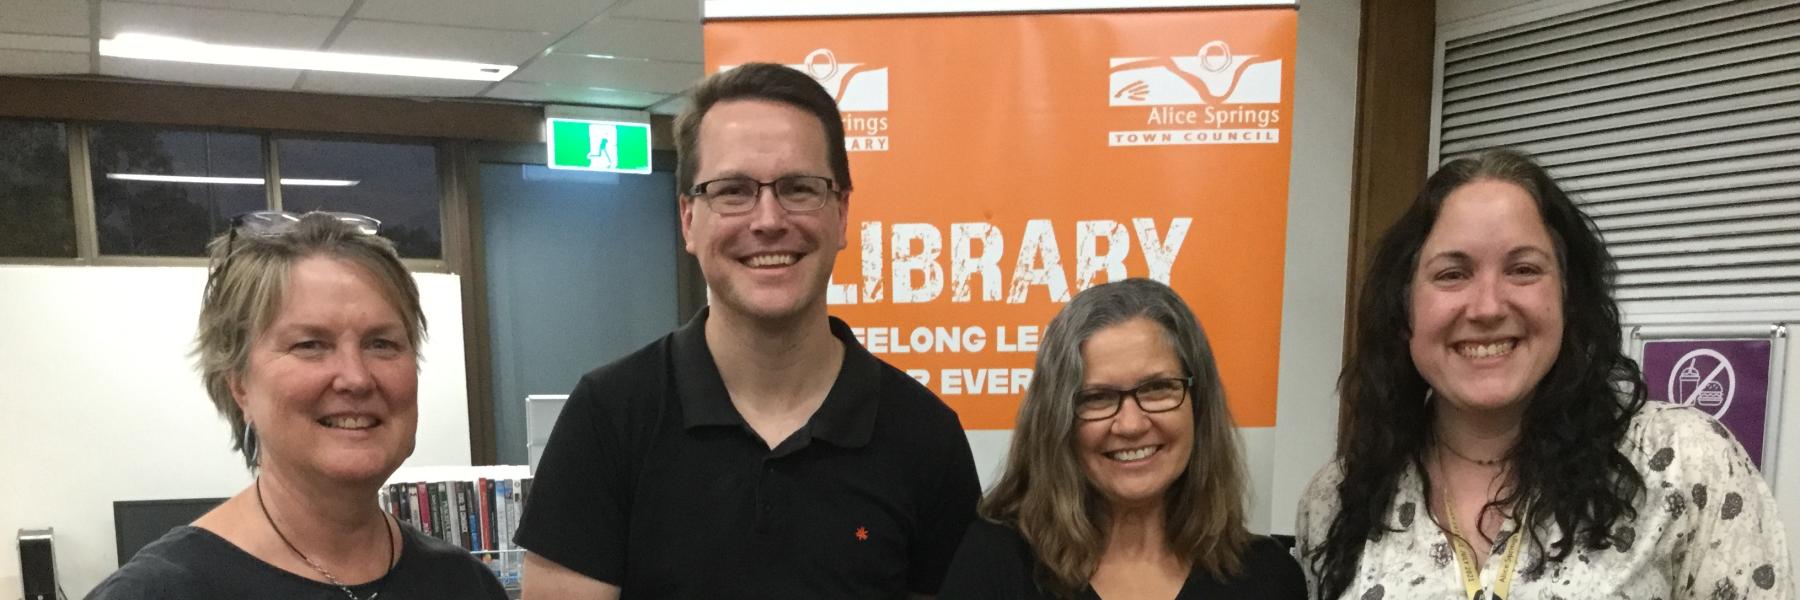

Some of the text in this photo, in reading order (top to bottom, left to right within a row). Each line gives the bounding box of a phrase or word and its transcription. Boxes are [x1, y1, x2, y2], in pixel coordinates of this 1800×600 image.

[842, 113, 888, 136] ings
[1147, 106, 1280, 128] Alice Springs
[851, 138, 886, 150] ARY
[1115, 131, 1274, 144] TOWN COUNCIL
[997, 325, 1048, 352] LE
[941, 368, 1033, 394] EVER
